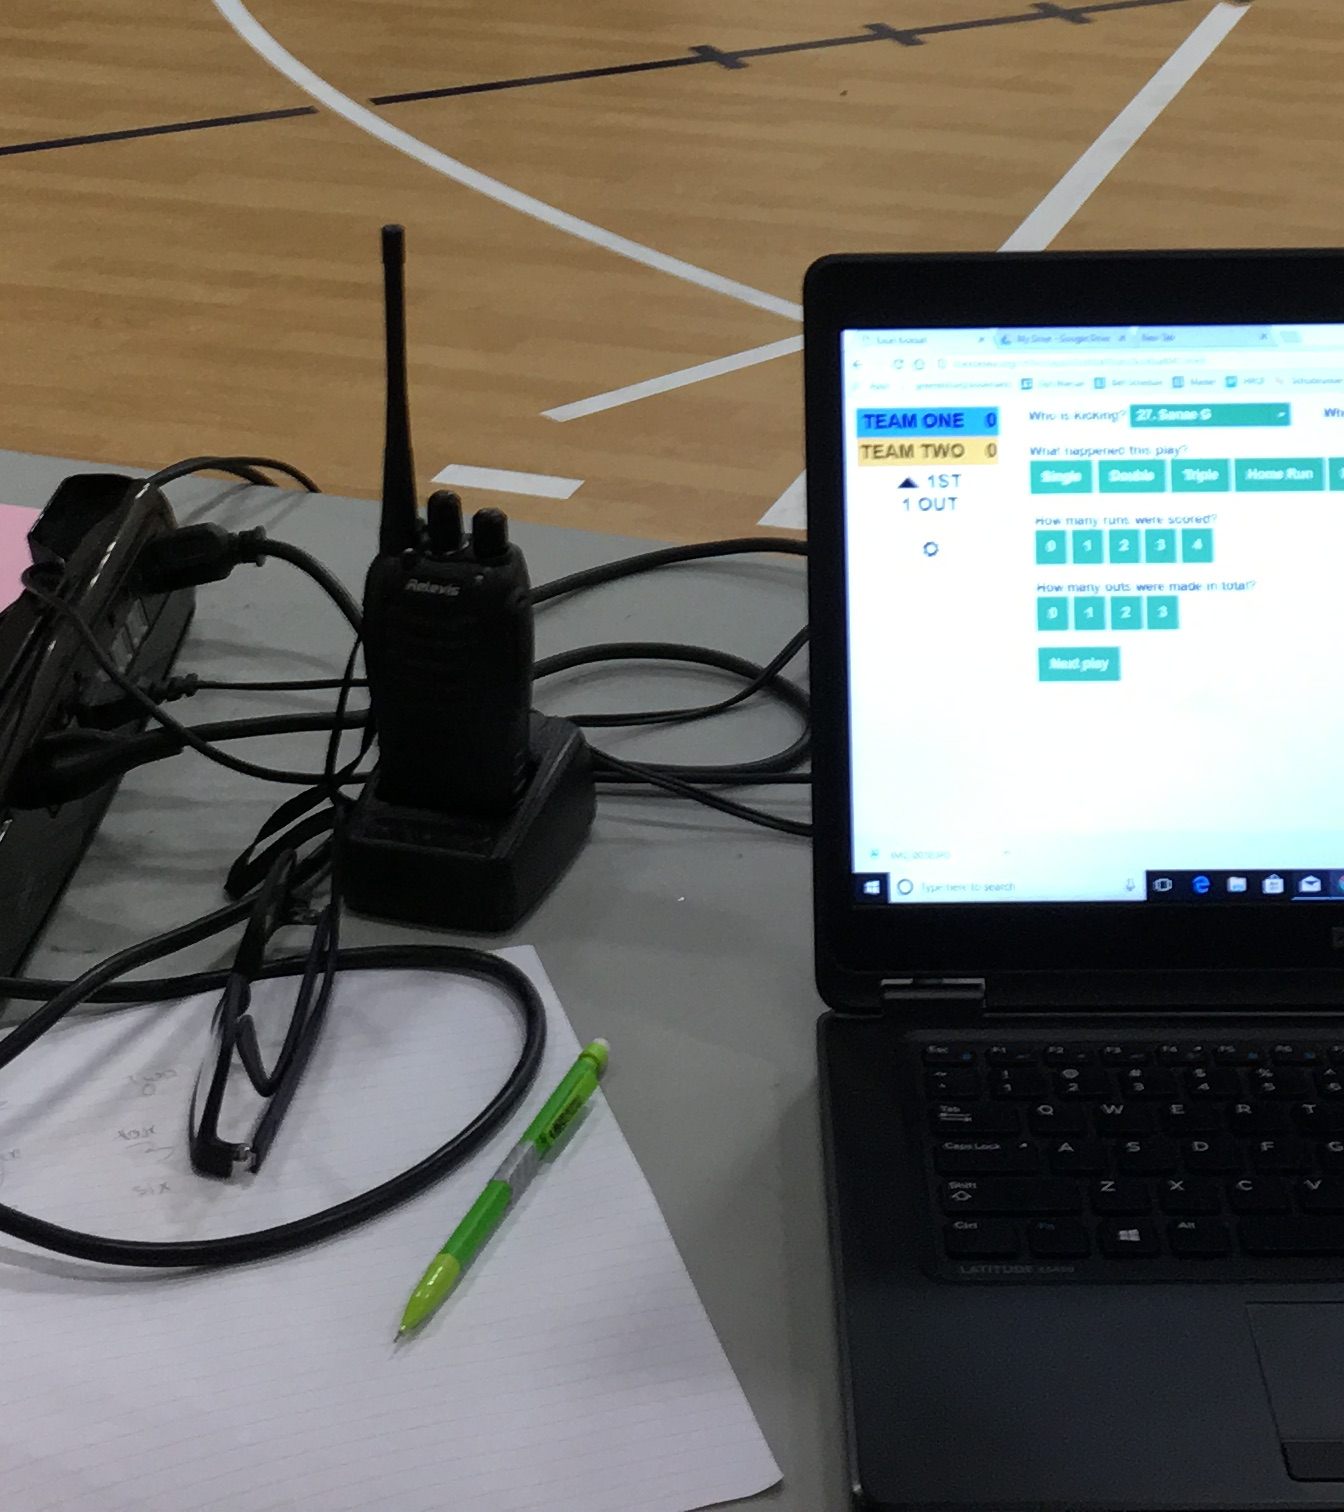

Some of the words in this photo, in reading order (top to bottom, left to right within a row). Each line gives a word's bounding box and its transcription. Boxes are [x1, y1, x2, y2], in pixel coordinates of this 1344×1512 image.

[863, 413, 917, 429] TEAM
[922, 412, 965, 428] ONE
[986, 412, 997, 428] 0
[1029, 411, 1056, 420] Who
[1060, 412, 1070, 421] is
[861, 444, 914, 459] TEAM
[920, 443, 965, 458] TWO
[986, 443, 997, 458] 0
[1030, 447, 1060, 456] What
[1065, 447, 1125, 458] happened
[1129, 445, 1151, 456] this
[1156, 444, 1188, 459] play?
[1108, 469, 1155, 482] Double
[1245, 468, 1283, 480] Home
[1285, 467, 1314, 480] Run
[928, 474, 962, 488] 1ST
[918, 496, 959, 512] OUT
[1035, 516, 1061, 526] How
[1066, 516, 1098, 528] many
[1103, 516, 1130, 526] runs
[1135, 516, 1164, 525] were
[1168, 513, 1218, 525] scored?
[1118, 538, 1130, 552] 2
[1154, 538, 1166, 551] 3
[1191, 537, 1203, 550] 4
[1037, 583, 1064, 593] How
[1067, 583, 1100, 595] many
[1105, 582, 1131, 592] outs
[1136, 582, 1164, 592] were
[1169, 581, 1203, 592] made
[1206, 581, 1218, 591] in
[1221, 580, 1257, 592] total?
[1120, 605, 1132, 619] 2
[1156, 604, 1168, 618] 3
[1048, 657, 1080, 670] Next
[1082, 657, 1110, 672] play
[921, 882, 943, 894] Type
[946, 883, 967, 892] here
[984, 882, 1016, 892] search
[1037, 1104, 1054, 1116] Q
[1101, 1103, 1125, 1115] W
[1169, 1103, 1186, 1115] E
[1235, 1103, 1253, 1115] R
[1301, 1103, 1317, 1115] T
[1057, 1142, 1074, 1153] A
[1125, 1141, 1142, 1153] S
[1191, 1141, 1209, 1152] D
[1260, 1141, 1275, 1152] F
[1327, 1141, 1344, 1152] G
[1100, 1180, 1116, 1192] Z
[1168, 1180, 1185, 1191] X
[1236, 1179, 1253, 1191] C
[1304, 1179, 1323, 1190] V
